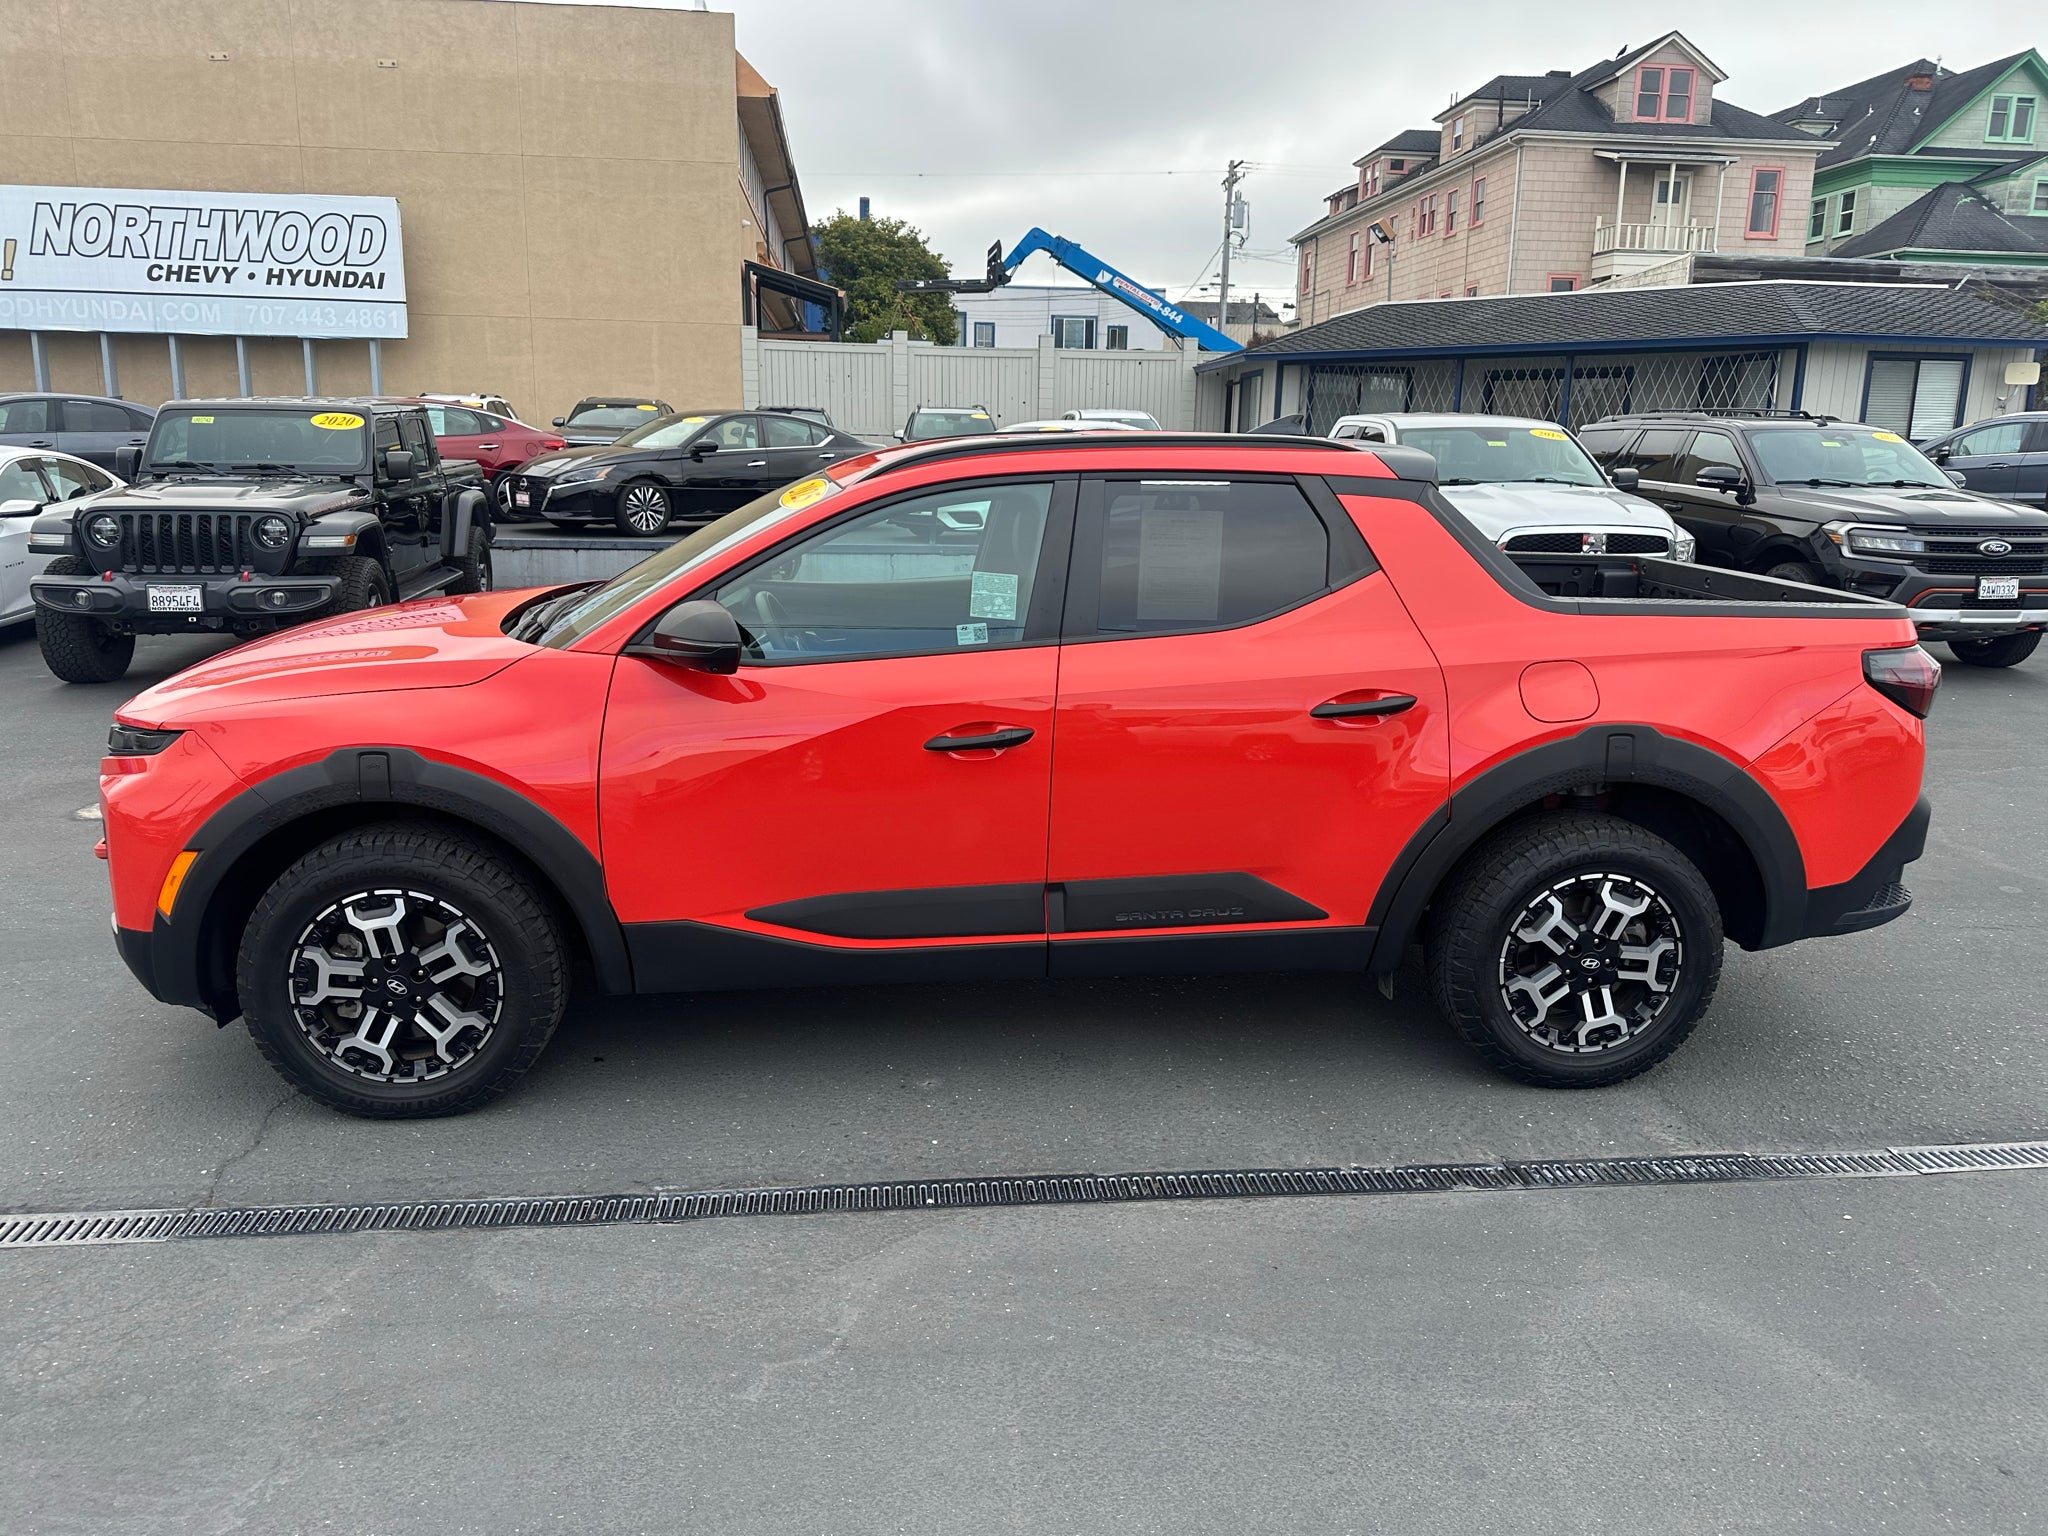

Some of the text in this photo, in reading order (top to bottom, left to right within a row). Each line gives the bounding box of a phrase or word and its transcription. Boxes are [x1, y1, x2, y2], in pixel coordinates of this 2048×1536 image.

[29, 202, 387, 267] NORTHWOOD
[146, 263, 386, 290] CHEVY HYUNDAI
[1115, 278, 1140, 296] RENTAL
[245, 304, 399, 329] 707.443.4861
[319, 416, 356, 426] 2020
[1981, 584, 2016, 595] 9AWD332
[151, 595, 200, 607] 88954F4
[1115, 907, 1244, 922] SANTA CRUZ
